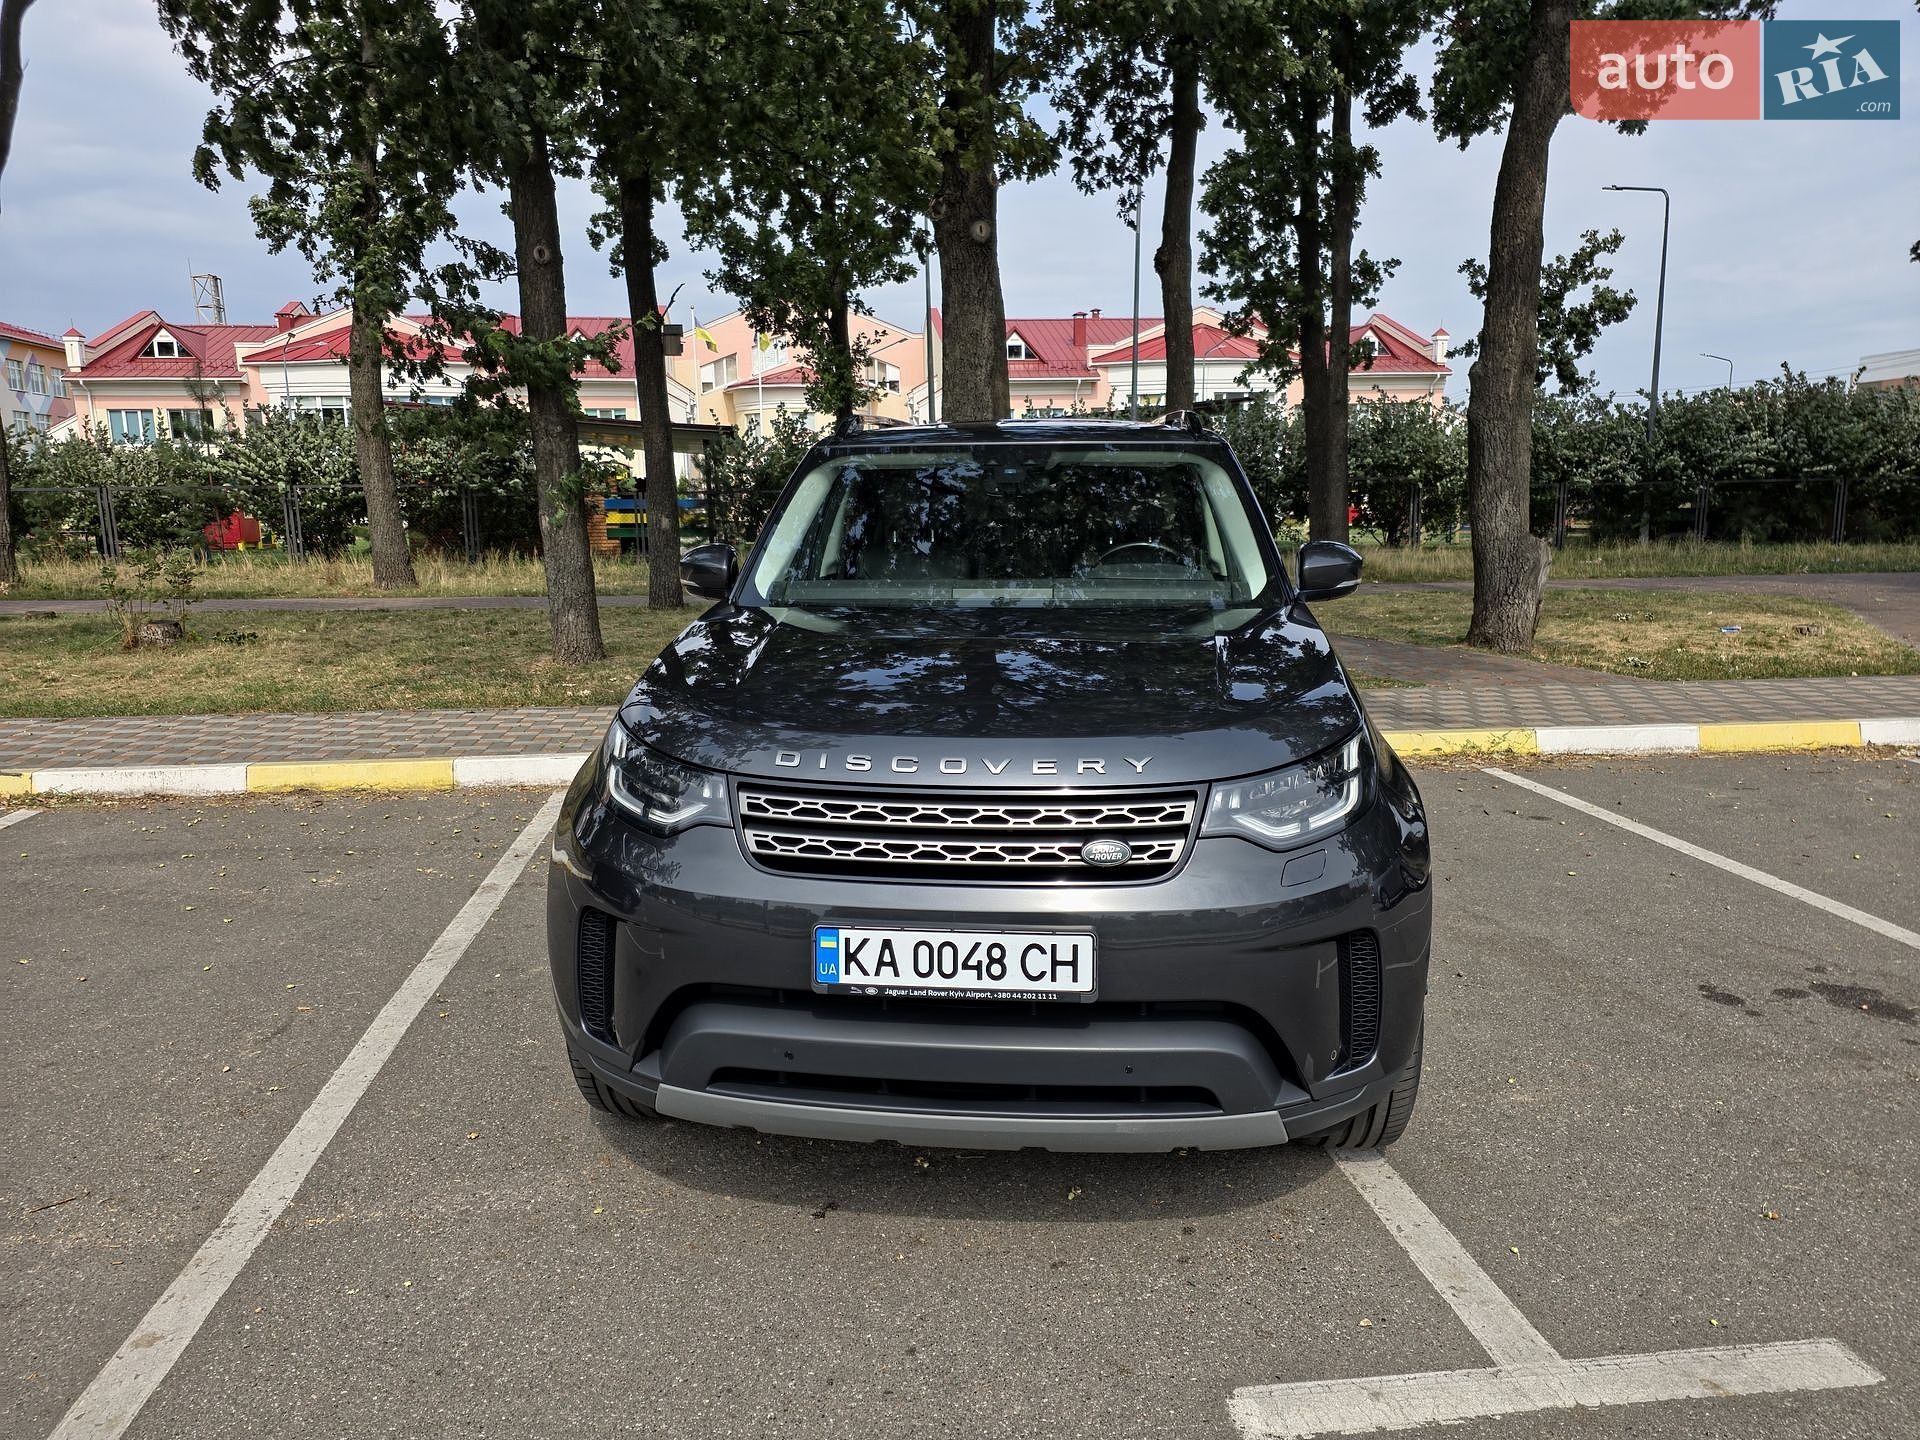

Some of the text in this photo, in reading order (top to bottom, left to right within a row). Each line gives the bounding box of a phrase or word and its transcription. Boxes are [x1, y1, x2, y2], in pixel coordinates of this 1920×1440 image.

[775, 749, 1155, 776] DISCOVERY
[1094, 852, 1122, 861] ROVER
[843, 936, 1079, 983] KA 0048 CH
[819, 962, 838, 976] UA
[884, 988, 908, 997] Jaguar
[909, 988, 927, 996] Land
[928, 989, 948, 997] Rover
[949, 990, 964, 999] Kyiv
[965, 991, 993, 1000] Airport,
